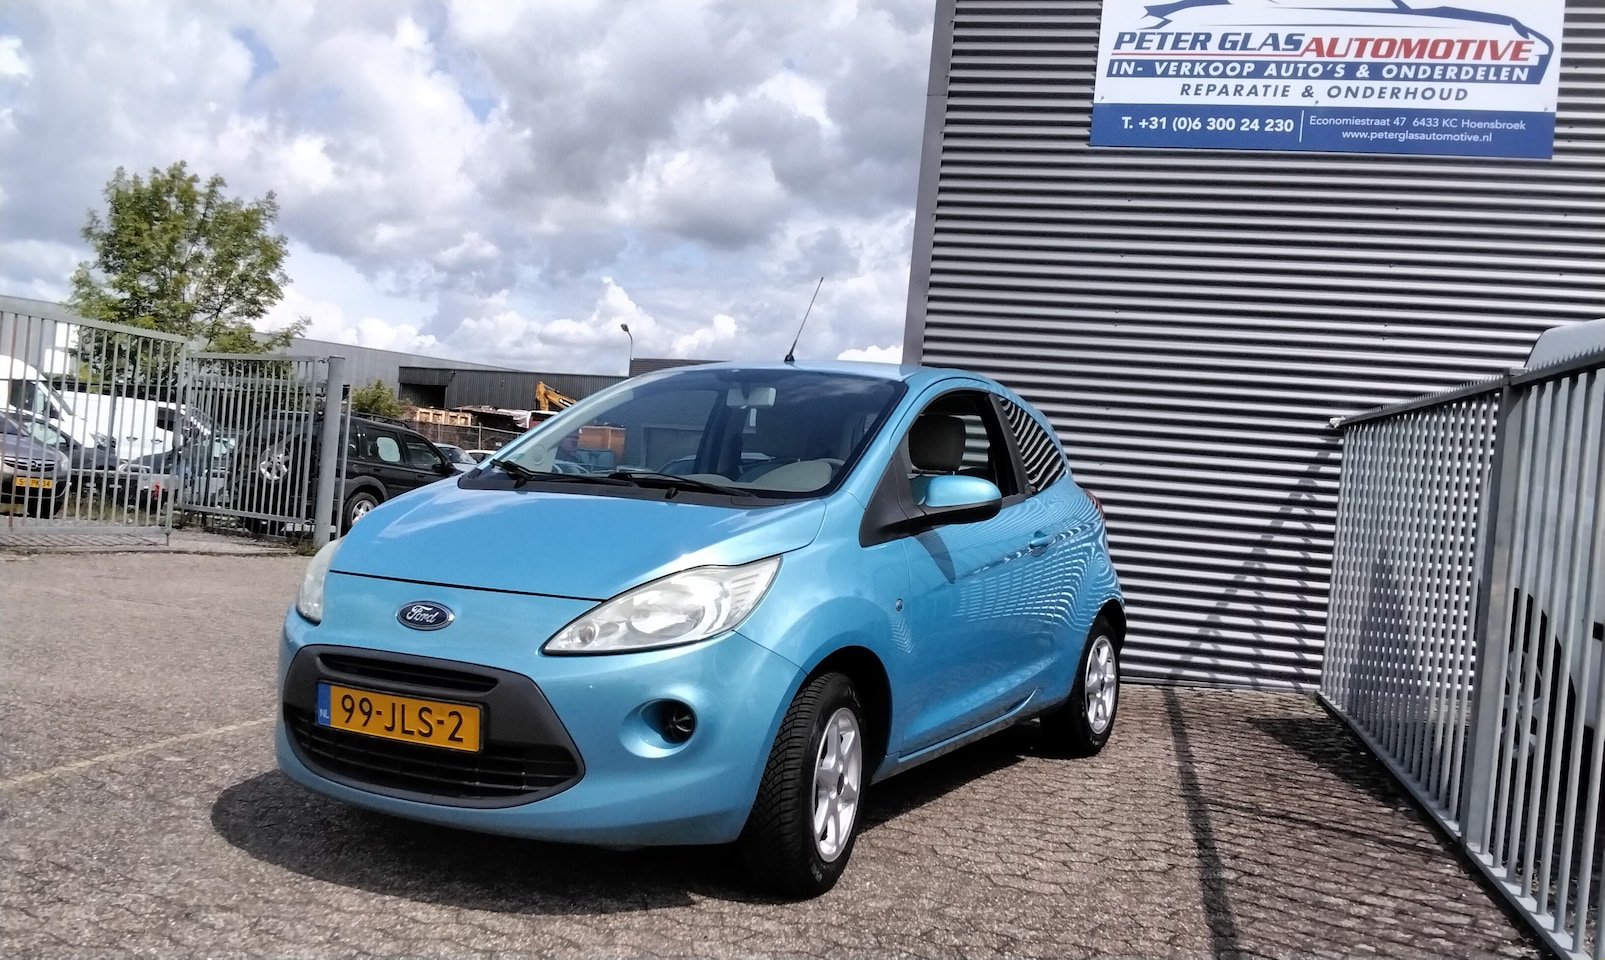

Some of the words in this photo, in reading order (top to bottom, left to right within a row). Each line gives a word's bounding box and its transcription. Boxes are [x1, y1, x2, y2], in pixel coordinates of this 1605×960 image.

[1112, 31, 1212, 51] PETER
[1111, 61, 1144, 75] IN-
[1154, 62, 1255, 76] VERKOOP
[1263, 63, 1346, 78] AUTO'S
[1356, 65, 1370, 78] &
[1382, 65, 1529, 82] ONDERDELEN
[1180, 83, 1291, 98] REPARATIE
[1301, 85, 1315, 98] &
[1327, 85, 1469, 101] ONDERHOUD
[1122, 116, 1134, 129] T.
[1138, 117, 1167, 130] +31
[1172, 117, 1202, 132] (0)6
[1206, 118, 1236, 131] 300
[1240, 118, 1260, 132] 24
[1264, 119, 1294, 132] 230
[1309, 116, 1390, 127] Economiestraat
[1393, 117, 1407, 127] 47
[1412, 118, 1439, 128] 6433
[1442, 118, 1458, 128] KC
[1461, 119, 1526, 131] Hoensbroek
[1342, 130, 1493, 143] www.peterglasautomotive.nl
[405, 605, 439, 624] Ford
[319, 708, 330, 719] NL
[341, 694, 464, 743] 99-JLS-2
